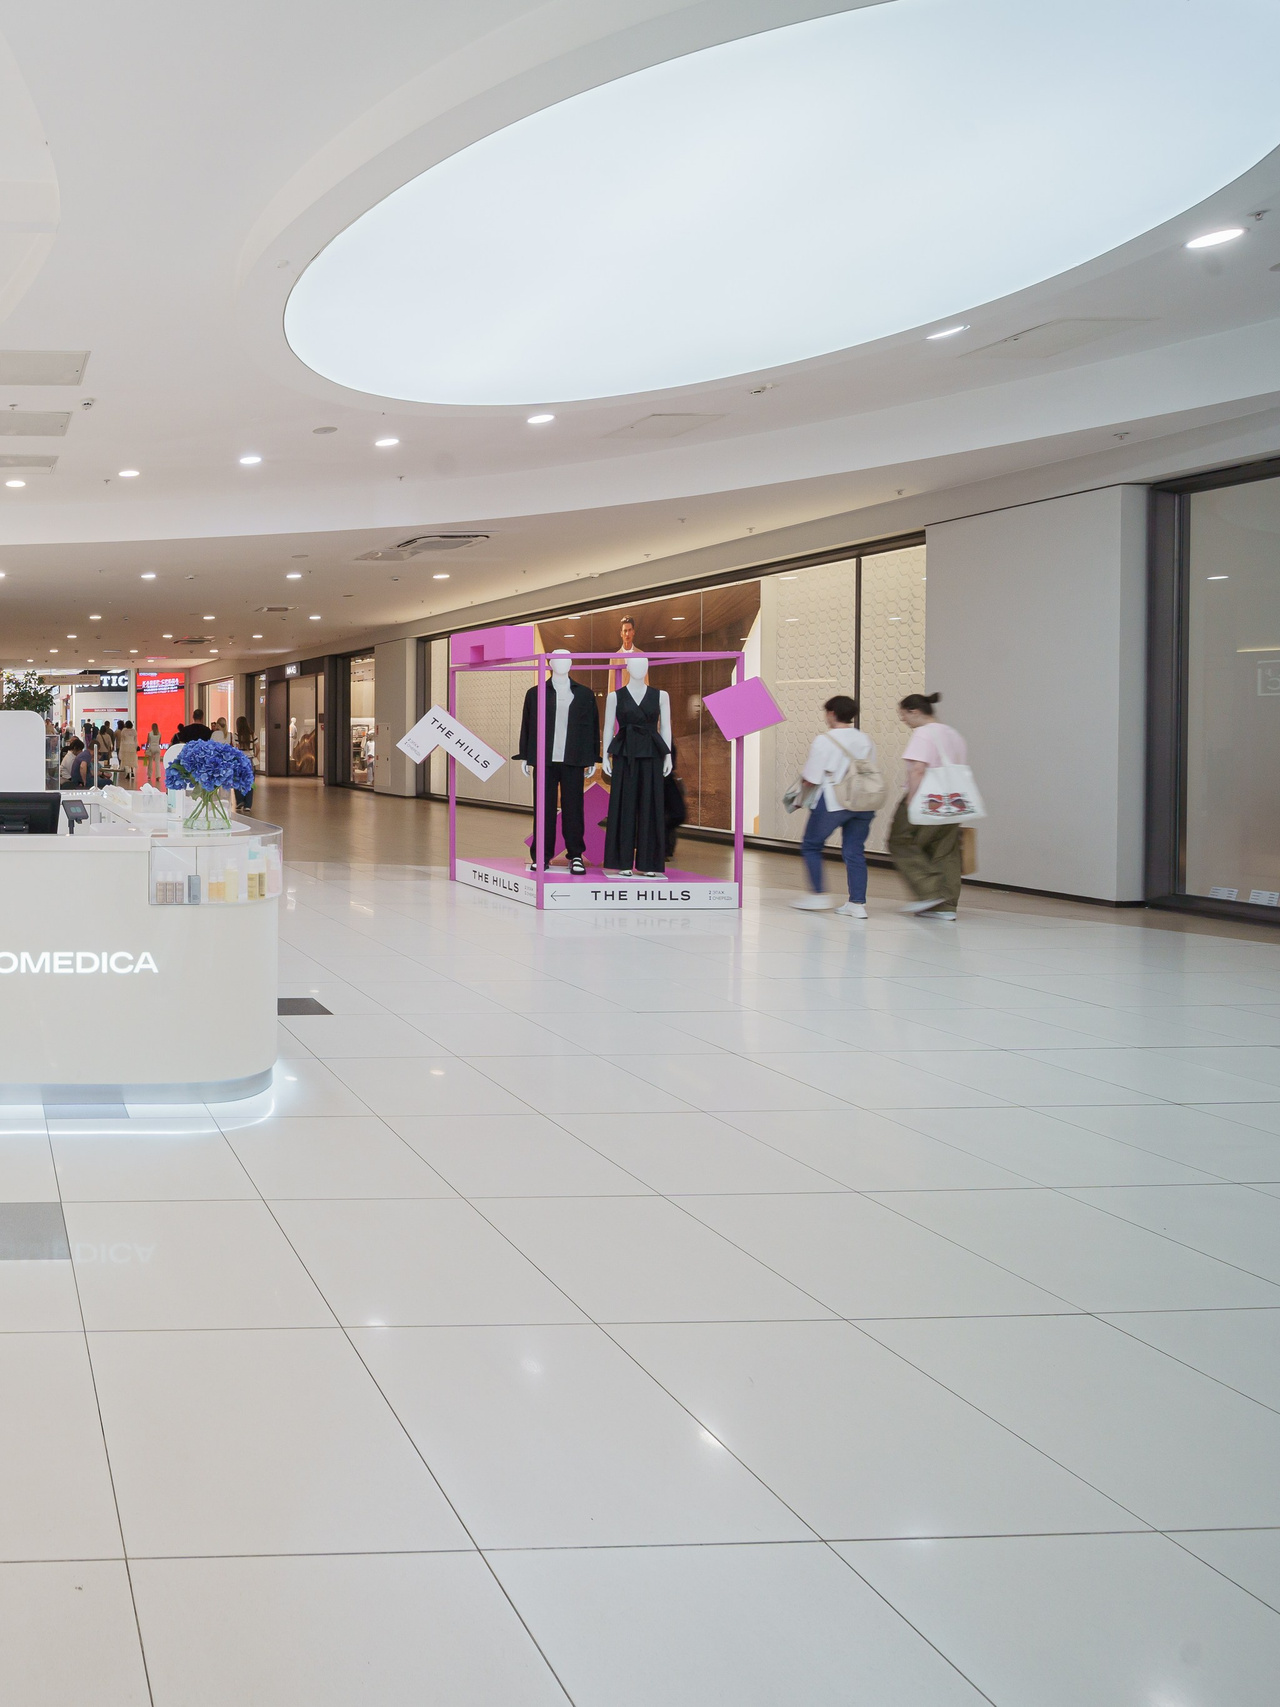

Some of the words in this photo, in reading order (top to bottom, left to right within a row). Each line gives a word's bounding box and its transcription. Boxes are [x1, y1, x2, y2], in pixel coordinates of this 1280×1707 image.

[430, 717, 455, 739] THE
[455, 738, 491, 769] HILLS
[472, 869, 489, 884] THE
[492, 875, 520, 893] HILLS
[590, 890, 628, 901] THE
[637, 890, 691, 901] HILLS
